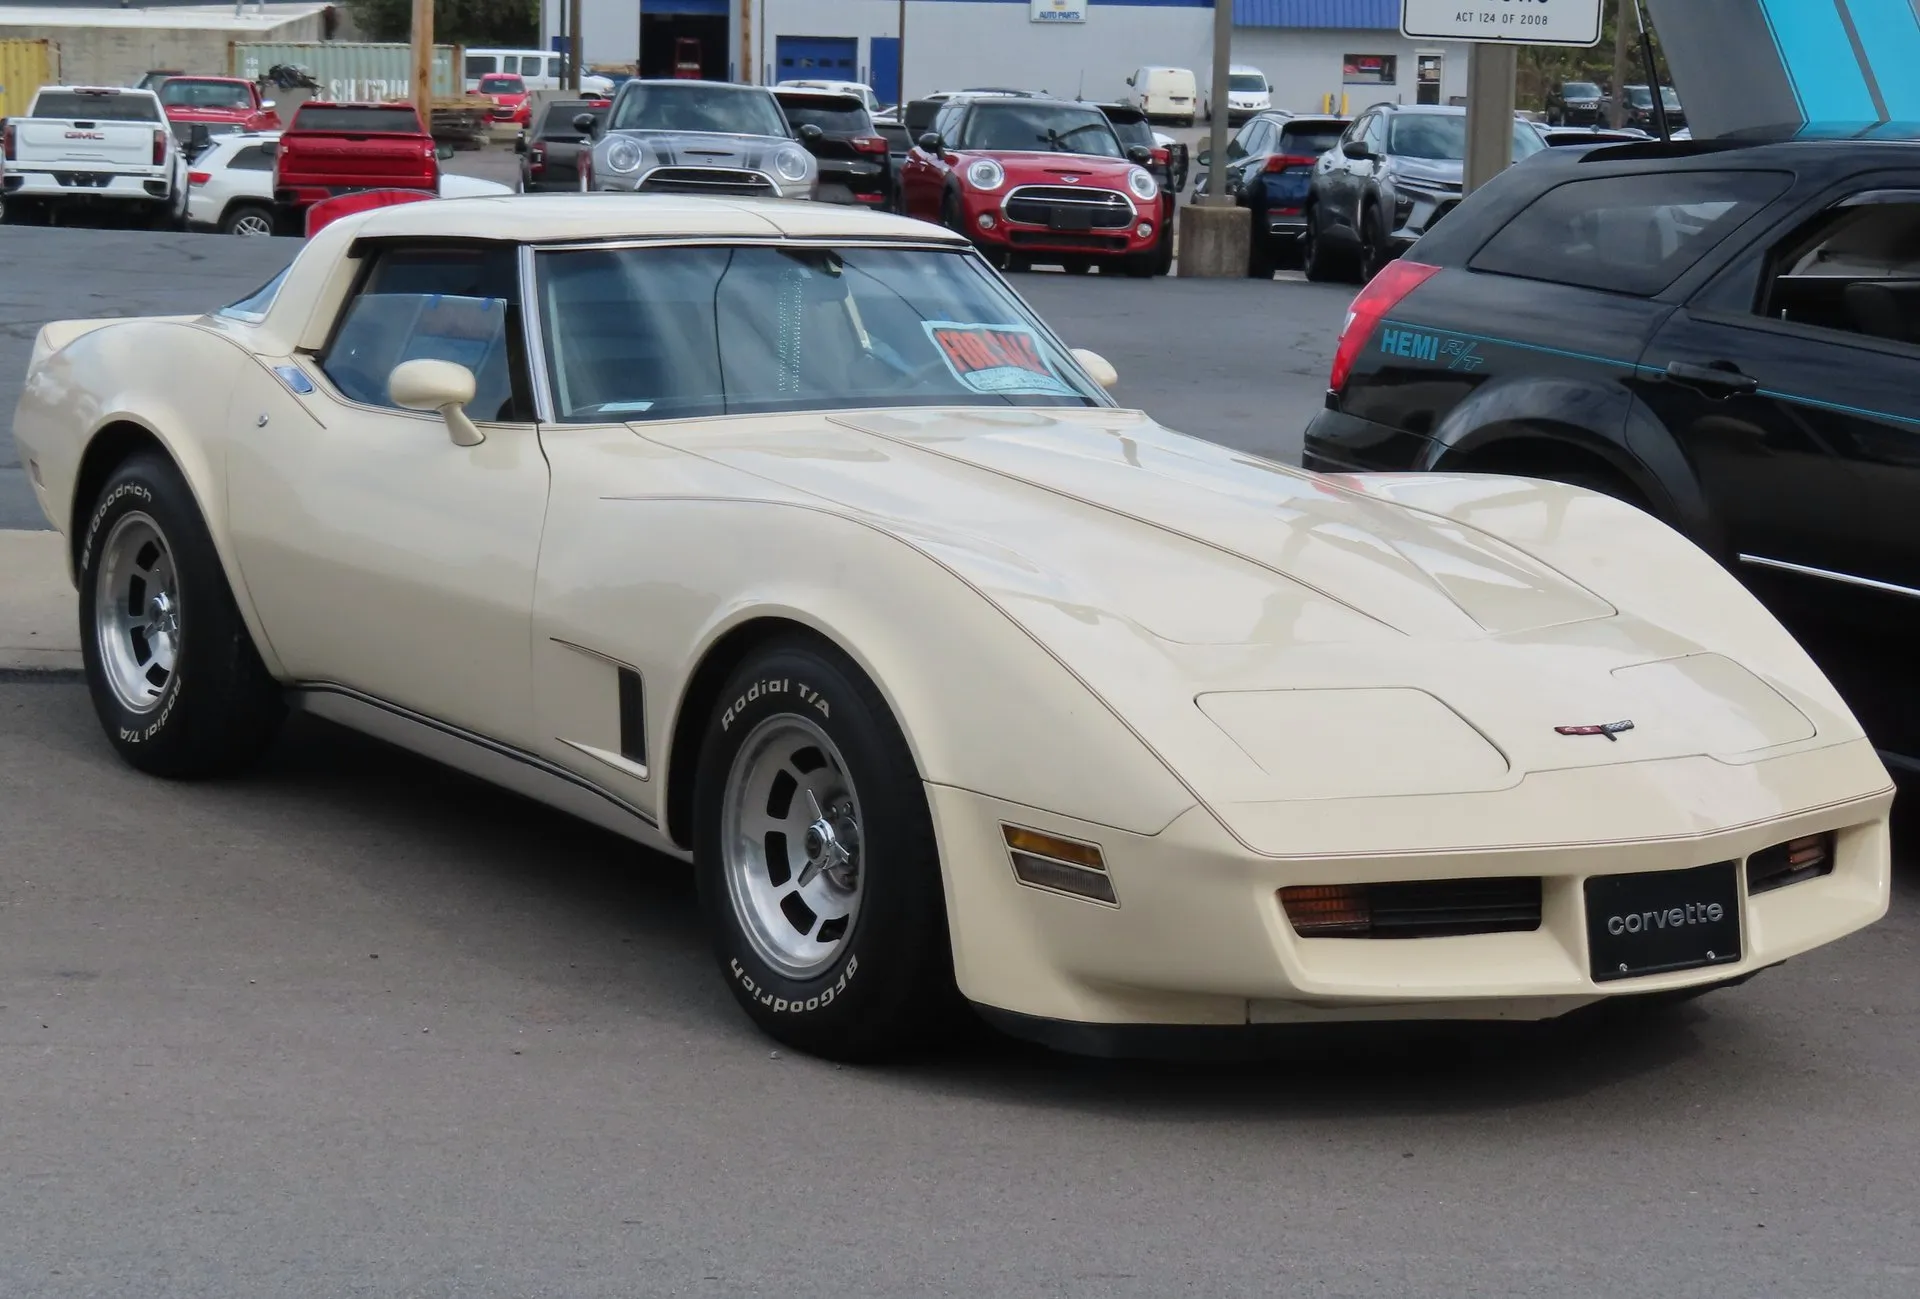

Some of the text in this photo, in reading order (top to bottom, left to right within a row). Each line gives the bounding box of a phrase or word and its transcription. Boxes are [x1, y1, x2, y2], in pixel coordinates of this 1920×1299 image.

[1040, 11, 1080, 19] AUTO PARTS
[1456, 12, 1548, 26] ACT 124 OF 2008
[65, 131, 105, 140] GMC
[935, 330, 1003, 372] FOR
[1381, 328, 1484, 371] HEMI R/T
[82, 483, 152, 571] BFGoodrich
[120, 674, 181, 743] Radial T/A
[721, 678, 829, 732] Radial T/A
[1607, 902, 1724, 936] corvette
[730, 954, 858, 1013] BFGoodrich
